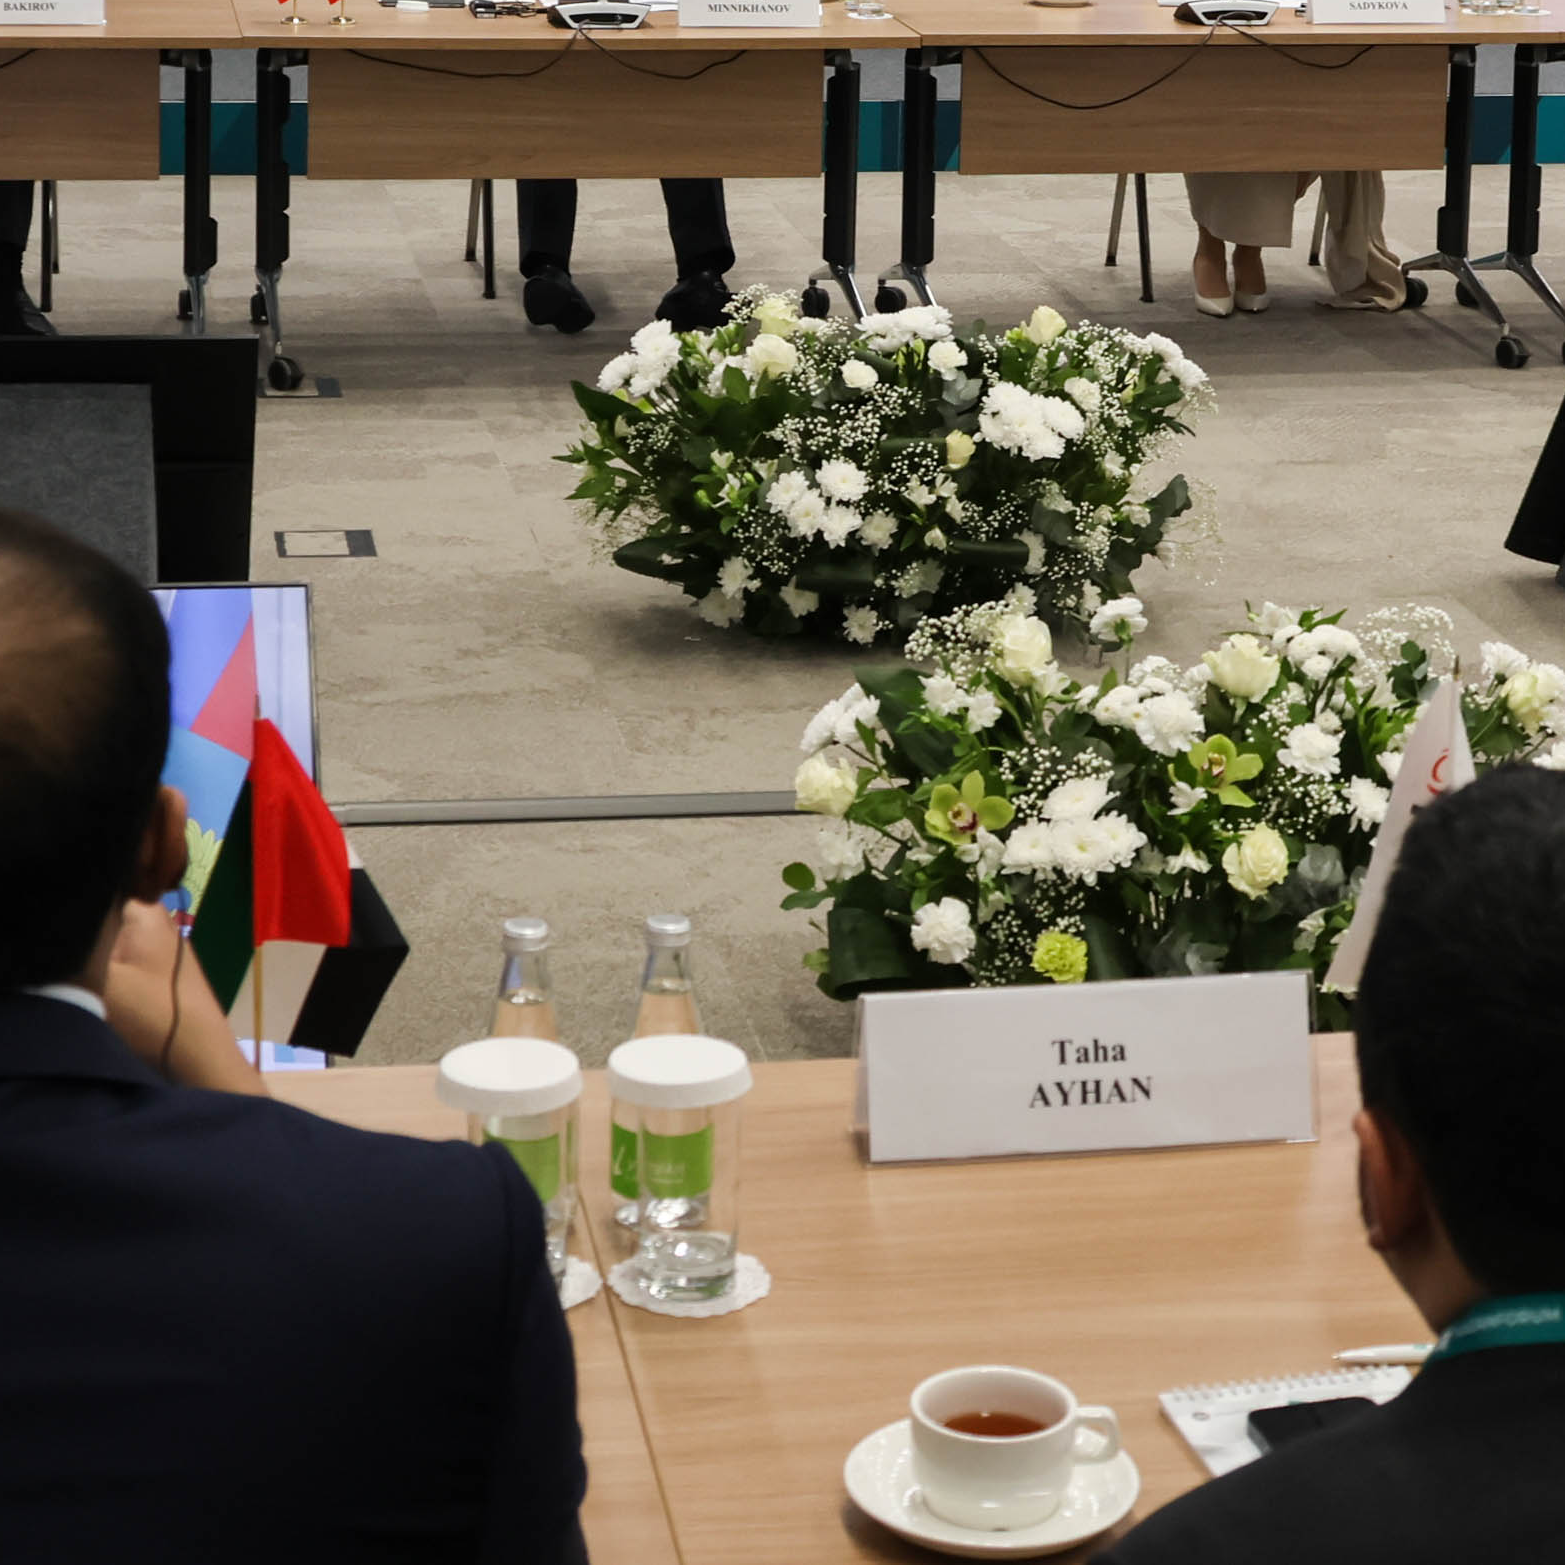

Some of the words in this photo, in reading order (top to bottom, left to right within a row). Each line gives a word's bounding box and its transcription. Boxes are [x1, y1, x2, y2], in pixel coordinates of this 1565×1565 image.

[3, 2, 57, 11] BAKIROV
[707, 4, 790, 13] MINNIKHANOV
[1349, 1, 1408, 10] SADYKOVA
[1051, 1038, 1127, 1065] Taha
[1029, 1076, 1153, 1109] AYHAN
